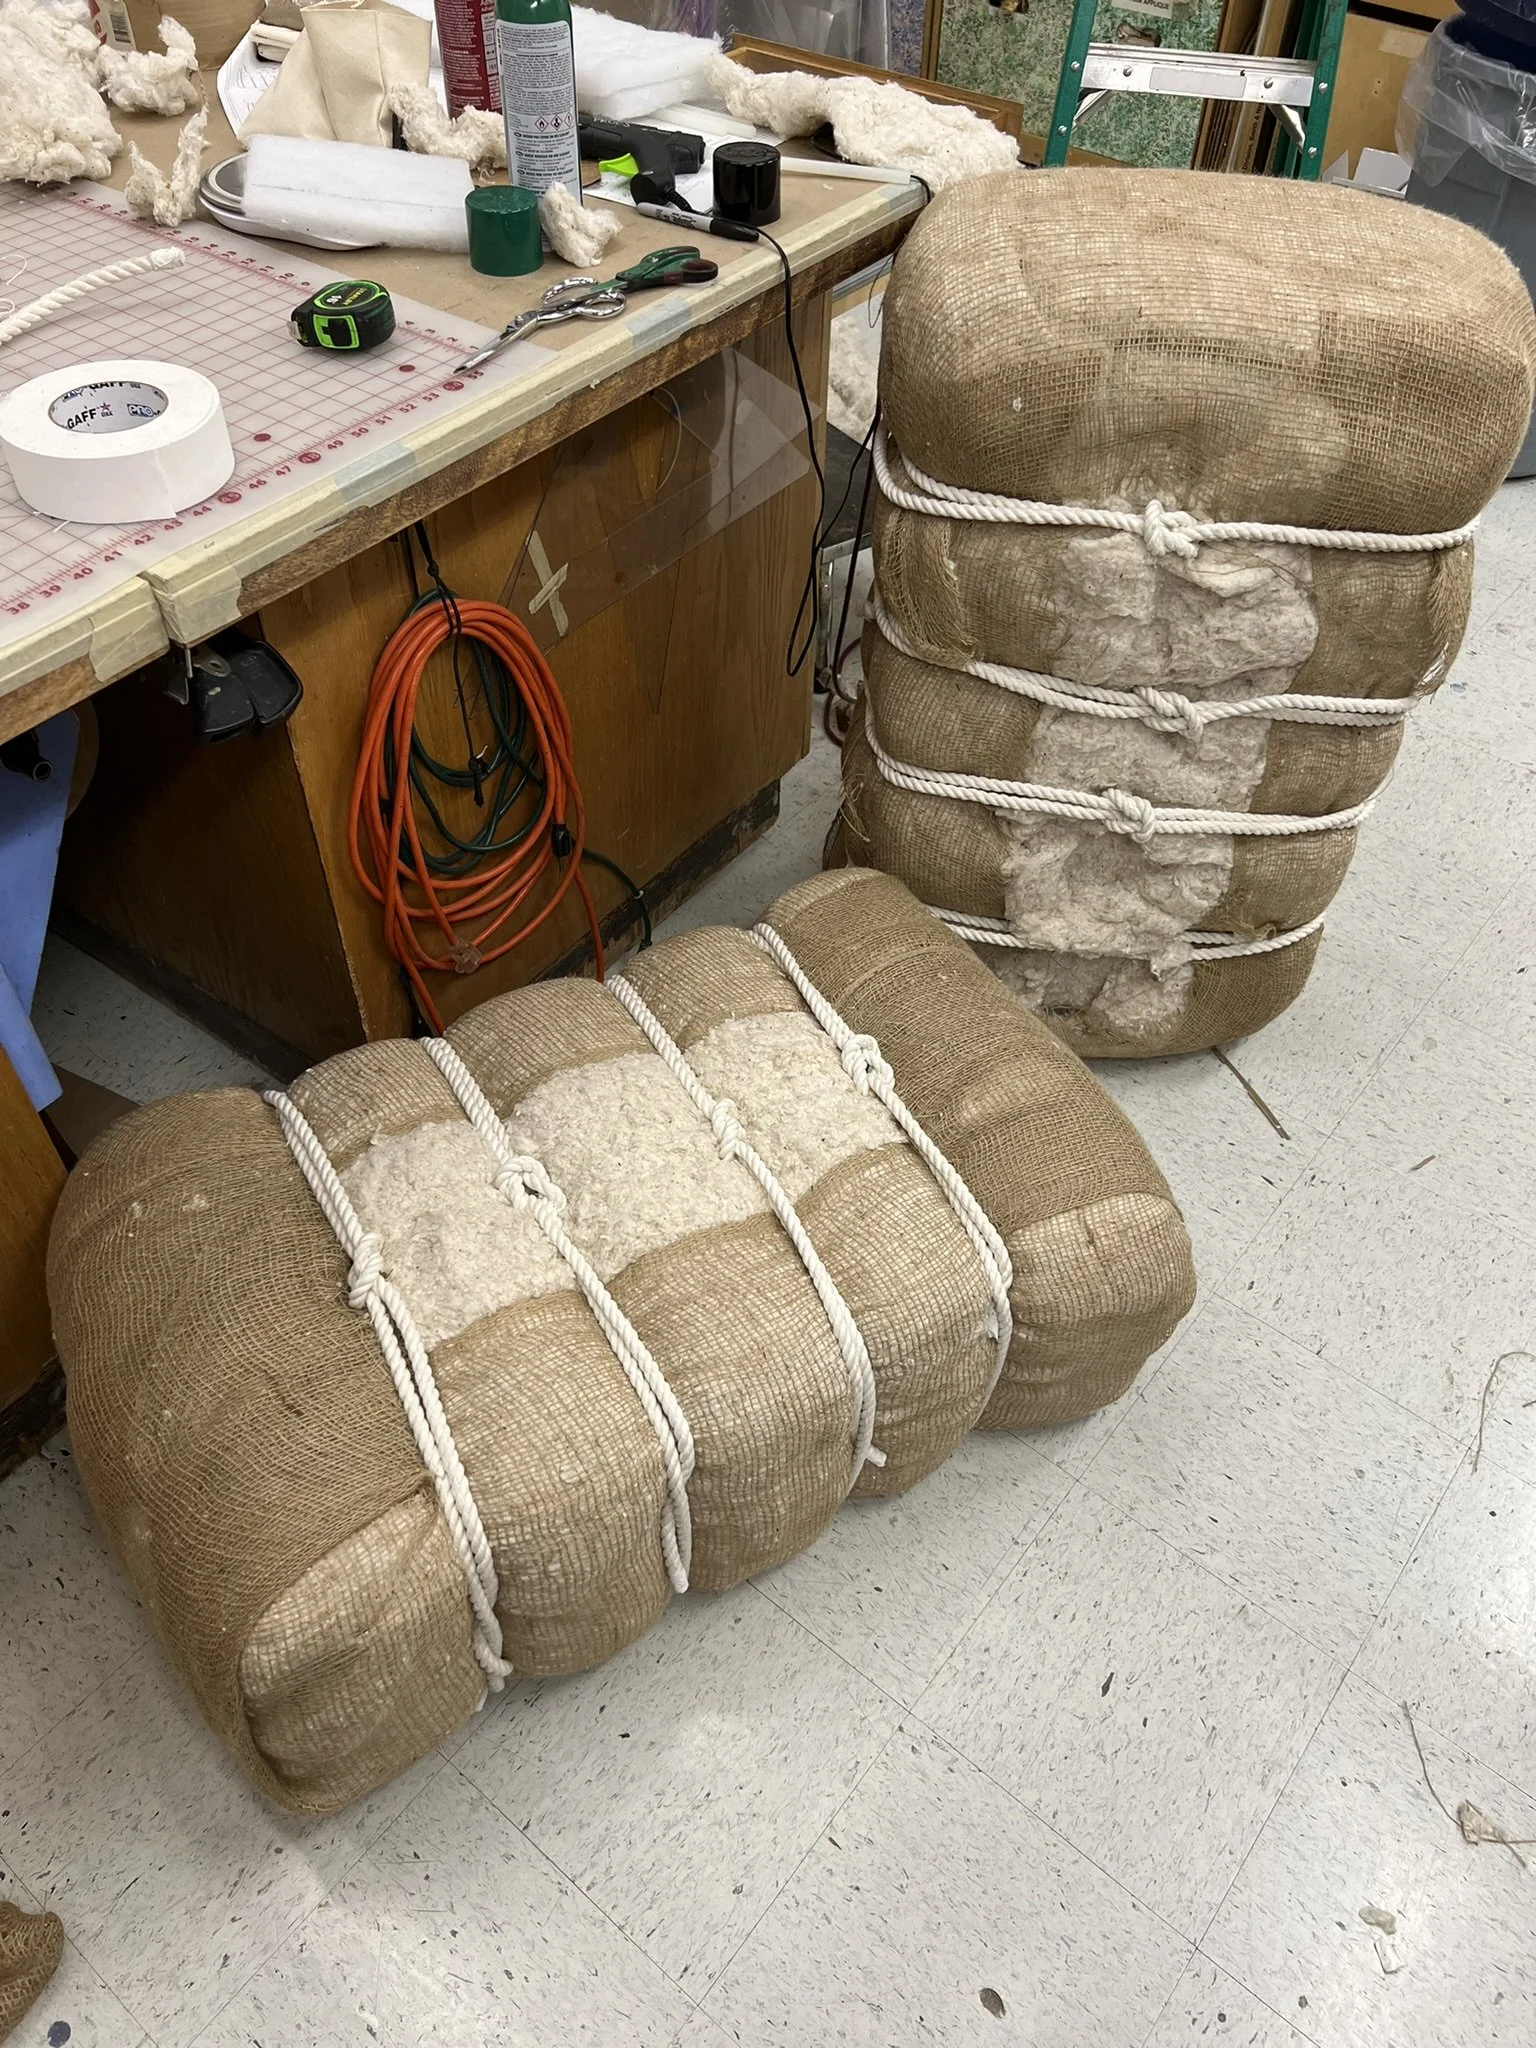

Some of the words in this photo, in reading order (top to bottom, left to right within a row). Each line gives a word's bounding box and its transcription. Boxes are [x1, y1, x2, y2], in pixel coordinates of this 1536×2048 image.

[66, 408, 98, 429] GAFF
[7, 601, 30, 615] 38
[40, 584, 62, 598] 39
[73, 566, 94, 580] 40
[104, 549, 123, 562] 41
[134, 534, 155, 546] 42
[164, 519, 183, 531] 43
[192, 505, 212, 517] 44
[249, 479, 267, 489] 46
[275, 465, 292, 476] 47
[327, 439, 344, 450] 49
[351, 427, 369, 438] 50
[375, 415, 393, 426] 51
[399, 403, 417, 414] 52
[422, 392, 440, 402] 53
[467, 370, 484, 380] 55
